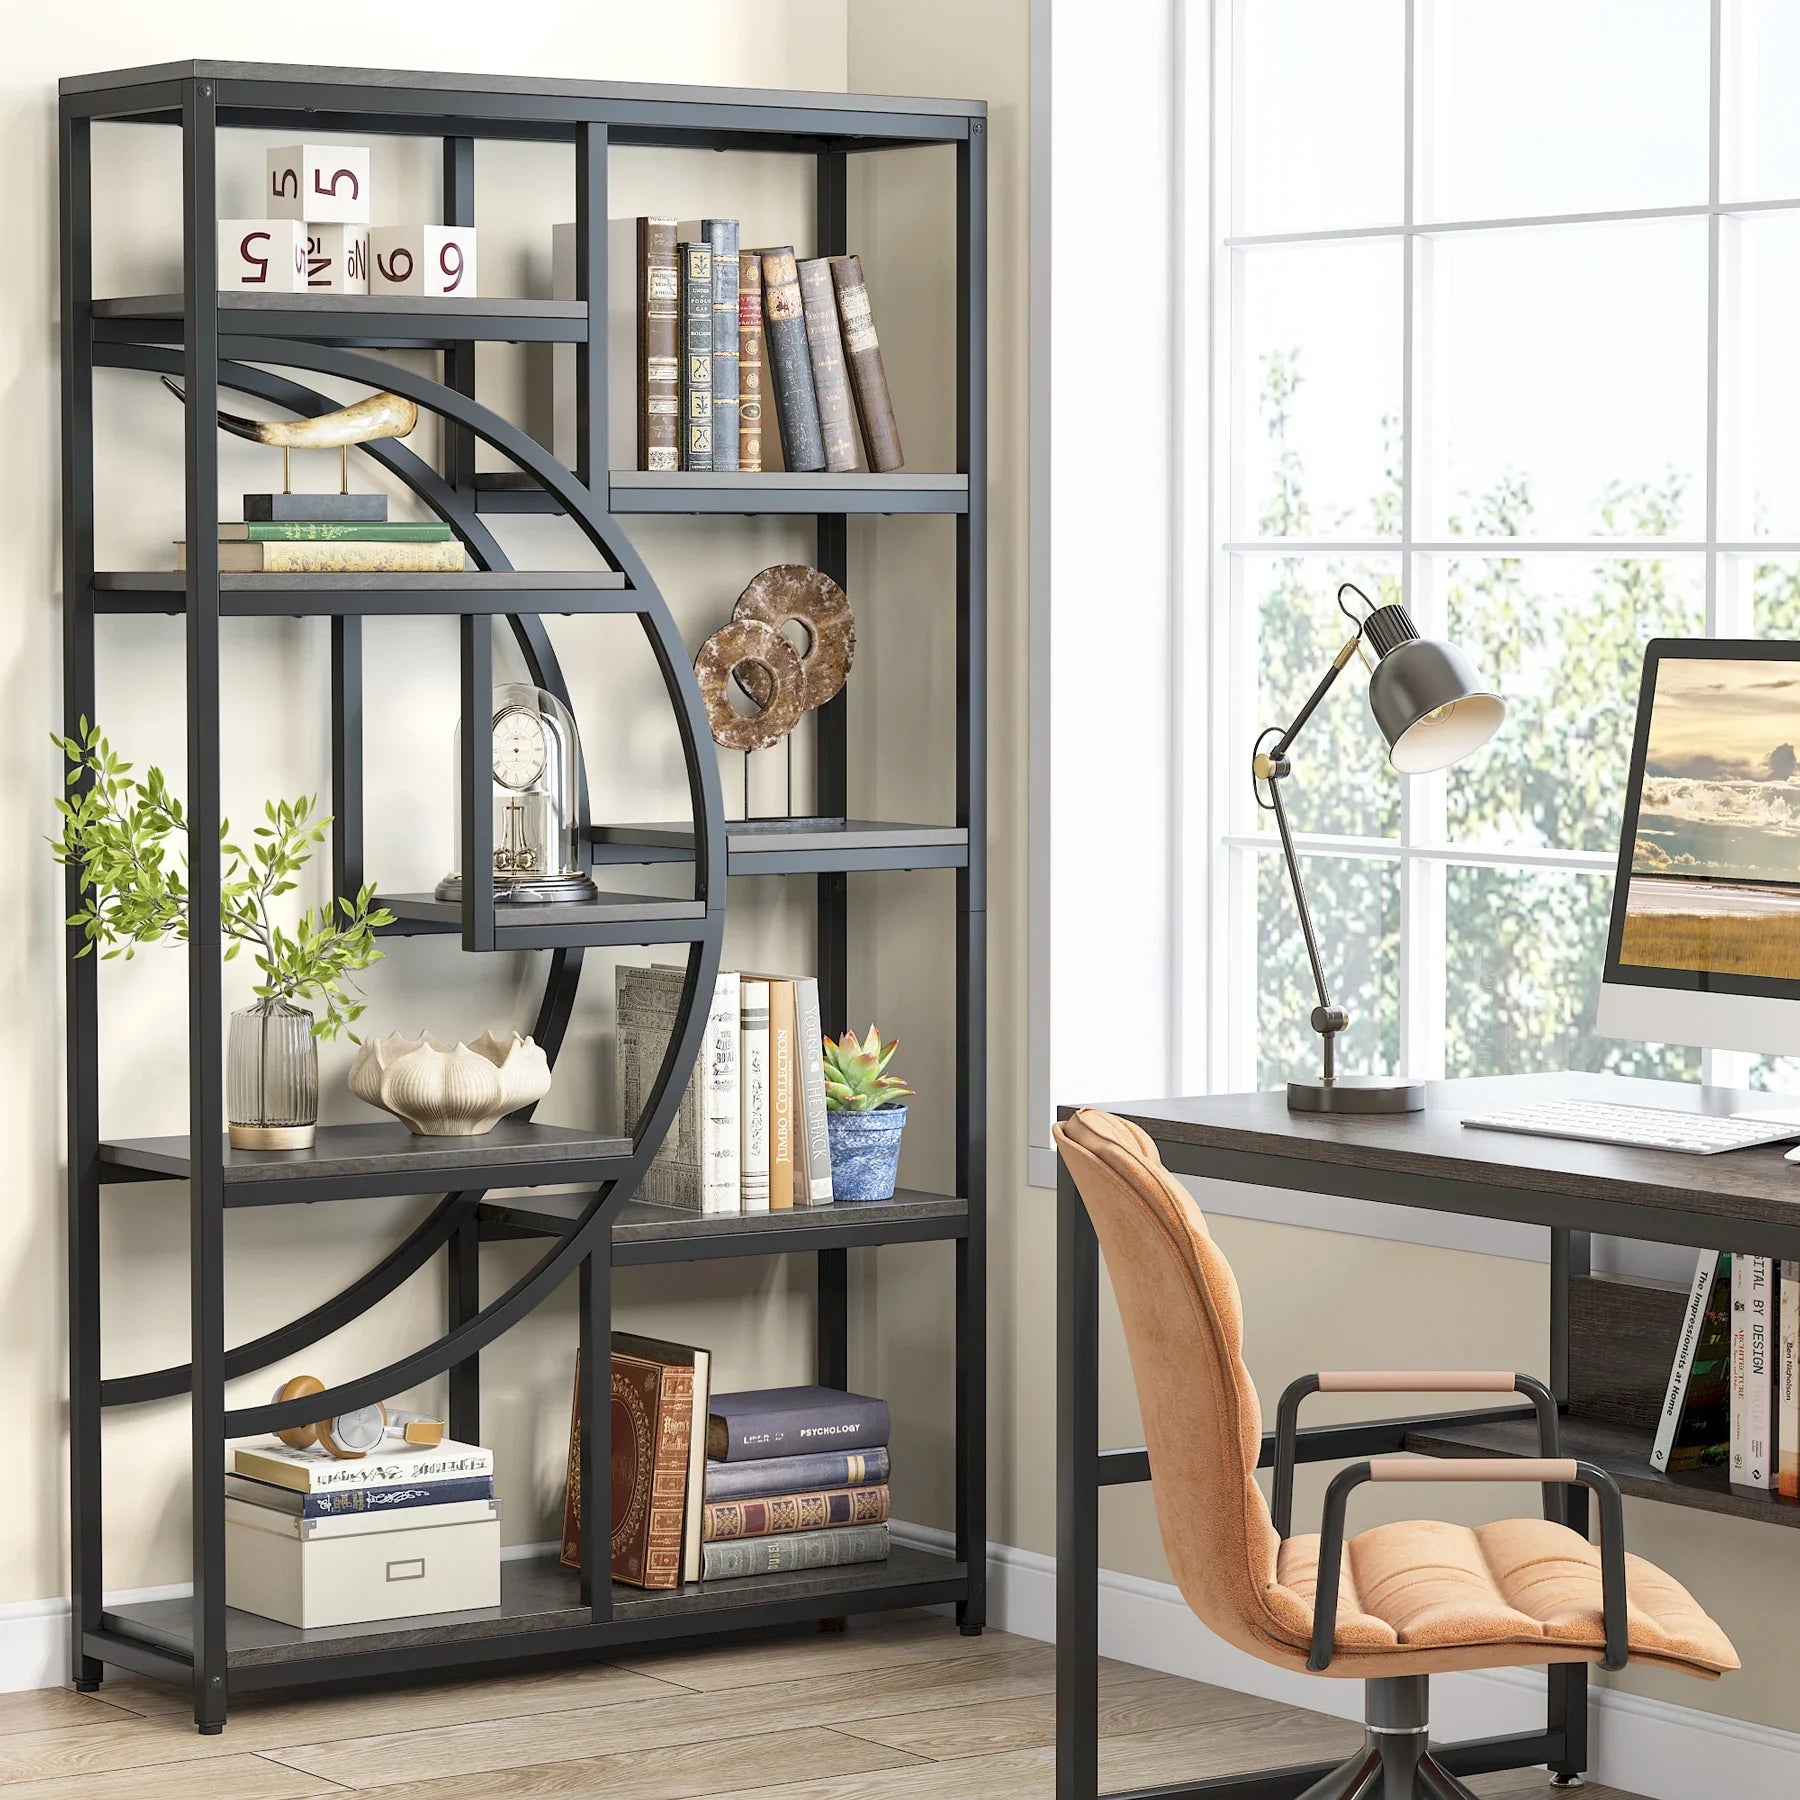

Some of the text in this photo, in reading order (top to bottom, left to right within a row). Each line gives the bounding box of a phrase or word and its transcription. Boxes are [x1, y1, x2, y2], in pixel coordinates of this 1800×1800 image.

[273, 168, 298, 199] 5
[314, 169, 359, 200] 5
[240, 232, 271, 283] 5
[804, 1006, 827, 1161] YOUNG THE SHACK
[775, 1117, 788, 1163] JUMBO
[1753, 1299, 1765, 1317] BY
[1666, 1271, 1709, 1416] The Impressionists at Home
[1752, 1324, 1765, 1375] DESIGN
[1785, 1361, 1793, 1401] Nicholson
[800, 1424, 861, 1437] PSYCHOLOGY
